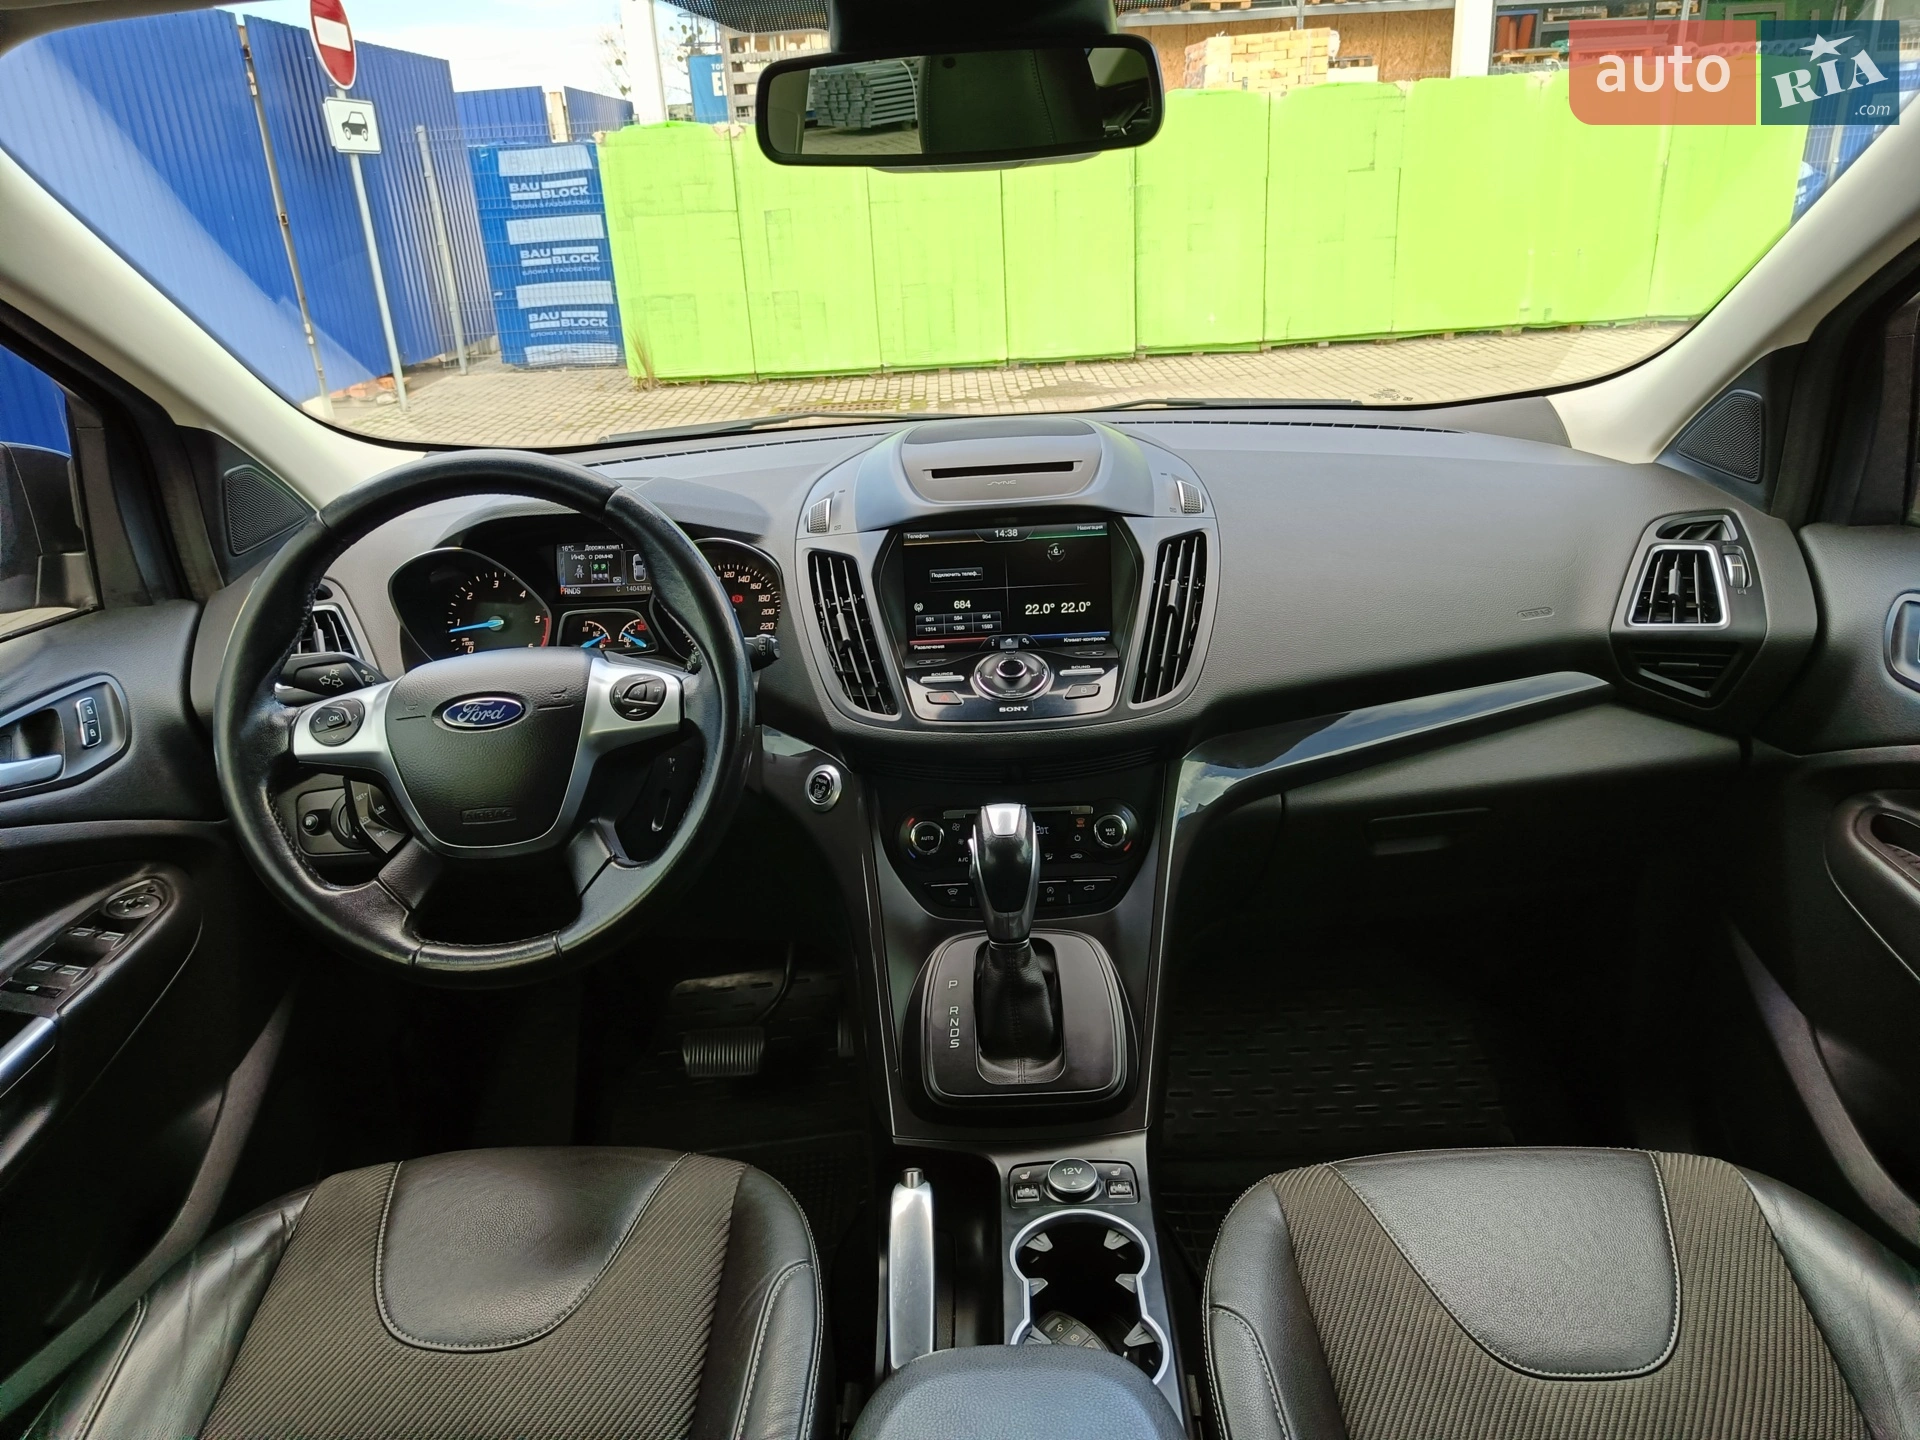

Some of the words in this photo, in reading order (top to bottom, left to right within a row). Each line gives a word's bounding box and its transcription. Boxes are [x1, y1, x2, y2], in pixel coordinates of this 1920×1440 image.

[509, 182, 540, 193] BAU
[541, 186, 589, 199] BLOCK
[520, 248, 551, 259] BAU
[552, 254, 600, 265] BLOCK
[528, 311, 560, 322] BAU
[561, 319, 609, 327] BLOCK
[995, 529, 1018, 538] 14:38
[738, 575, 750, 583] 140
[750, 582, 762, 590] 160
[466, 592, 473, 600] 2
[519, 590, 526, 598] 4
[758, 594, 770, 602] 180
[953, 600, 971, 609] 684
[1025, 603, 1055, 615] 22.0°
[1060, 601, 1091, 613] 22.0°
[760, 622, 774, 630] 220
[457, 701, 507, 722] Ford
[948, 980, 958, 988] P
[1061, 1167, 1083, 1175] 12V
